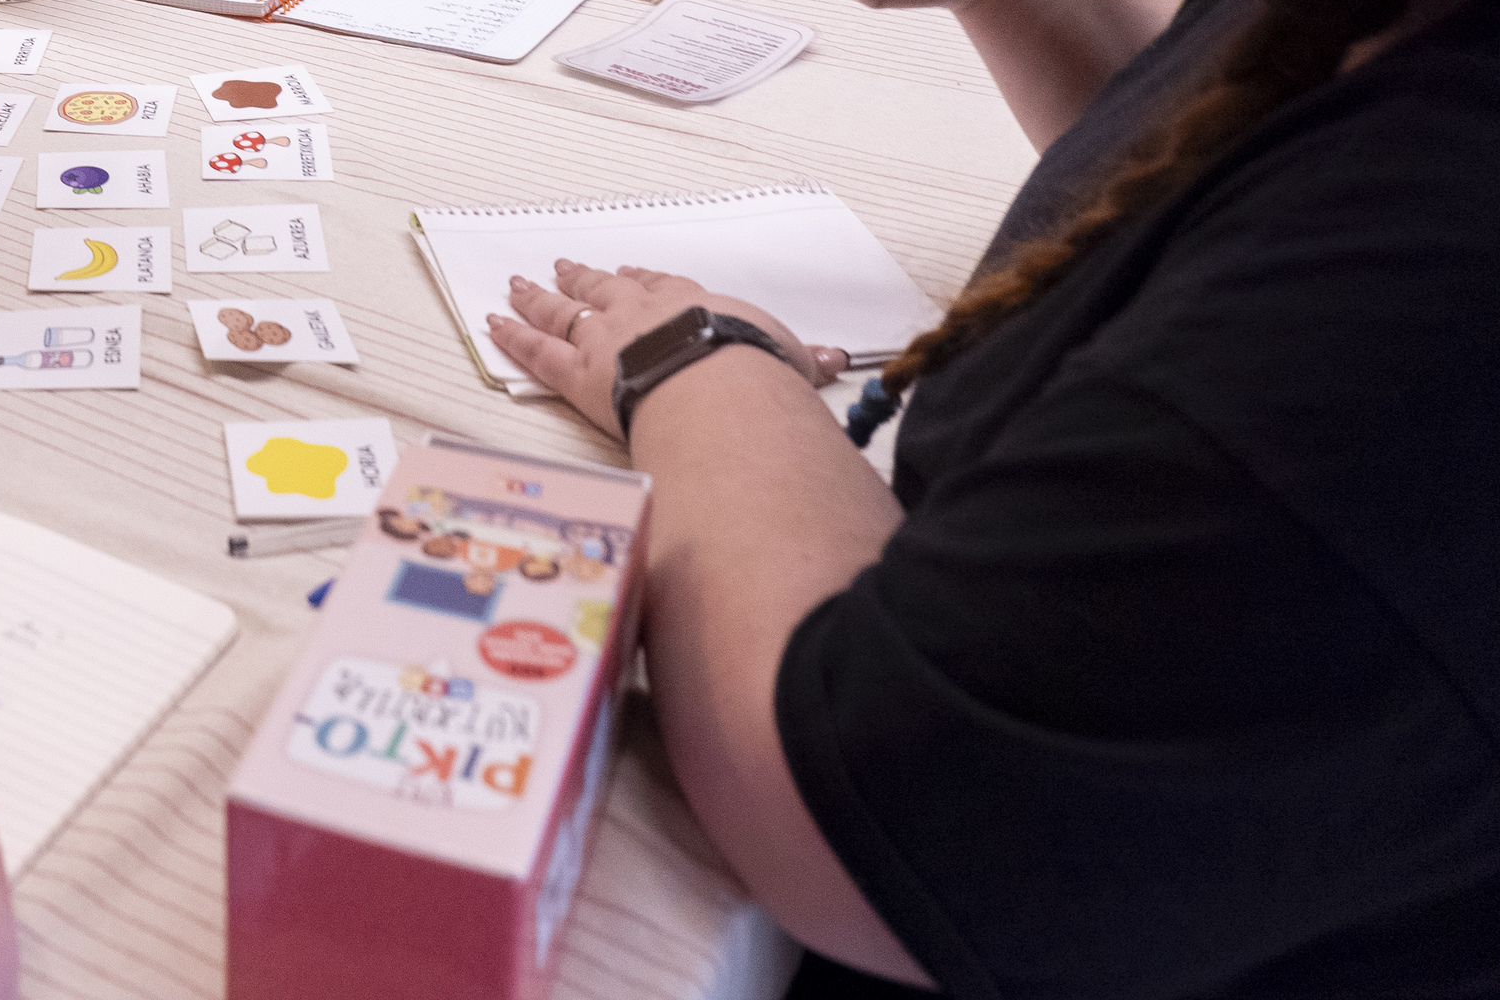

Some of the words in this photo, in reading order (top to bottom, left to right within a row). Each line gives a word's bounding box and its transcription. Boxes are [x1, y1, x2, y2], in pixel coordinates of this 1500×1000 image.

[14, 37, 37, 67] PERRITOA
[283, 73, 313, 107] MARROIA
[141, 100, 160, 121] PIZZA
[139, 163, 152, 195] AHABIA
[290, 217, 309, 261] AZUKREA
[137, 235, 155, 284] PLATANOA
[103, 327, 123, 365] ESNEA
[358, 443, 381, 488] HORIA
